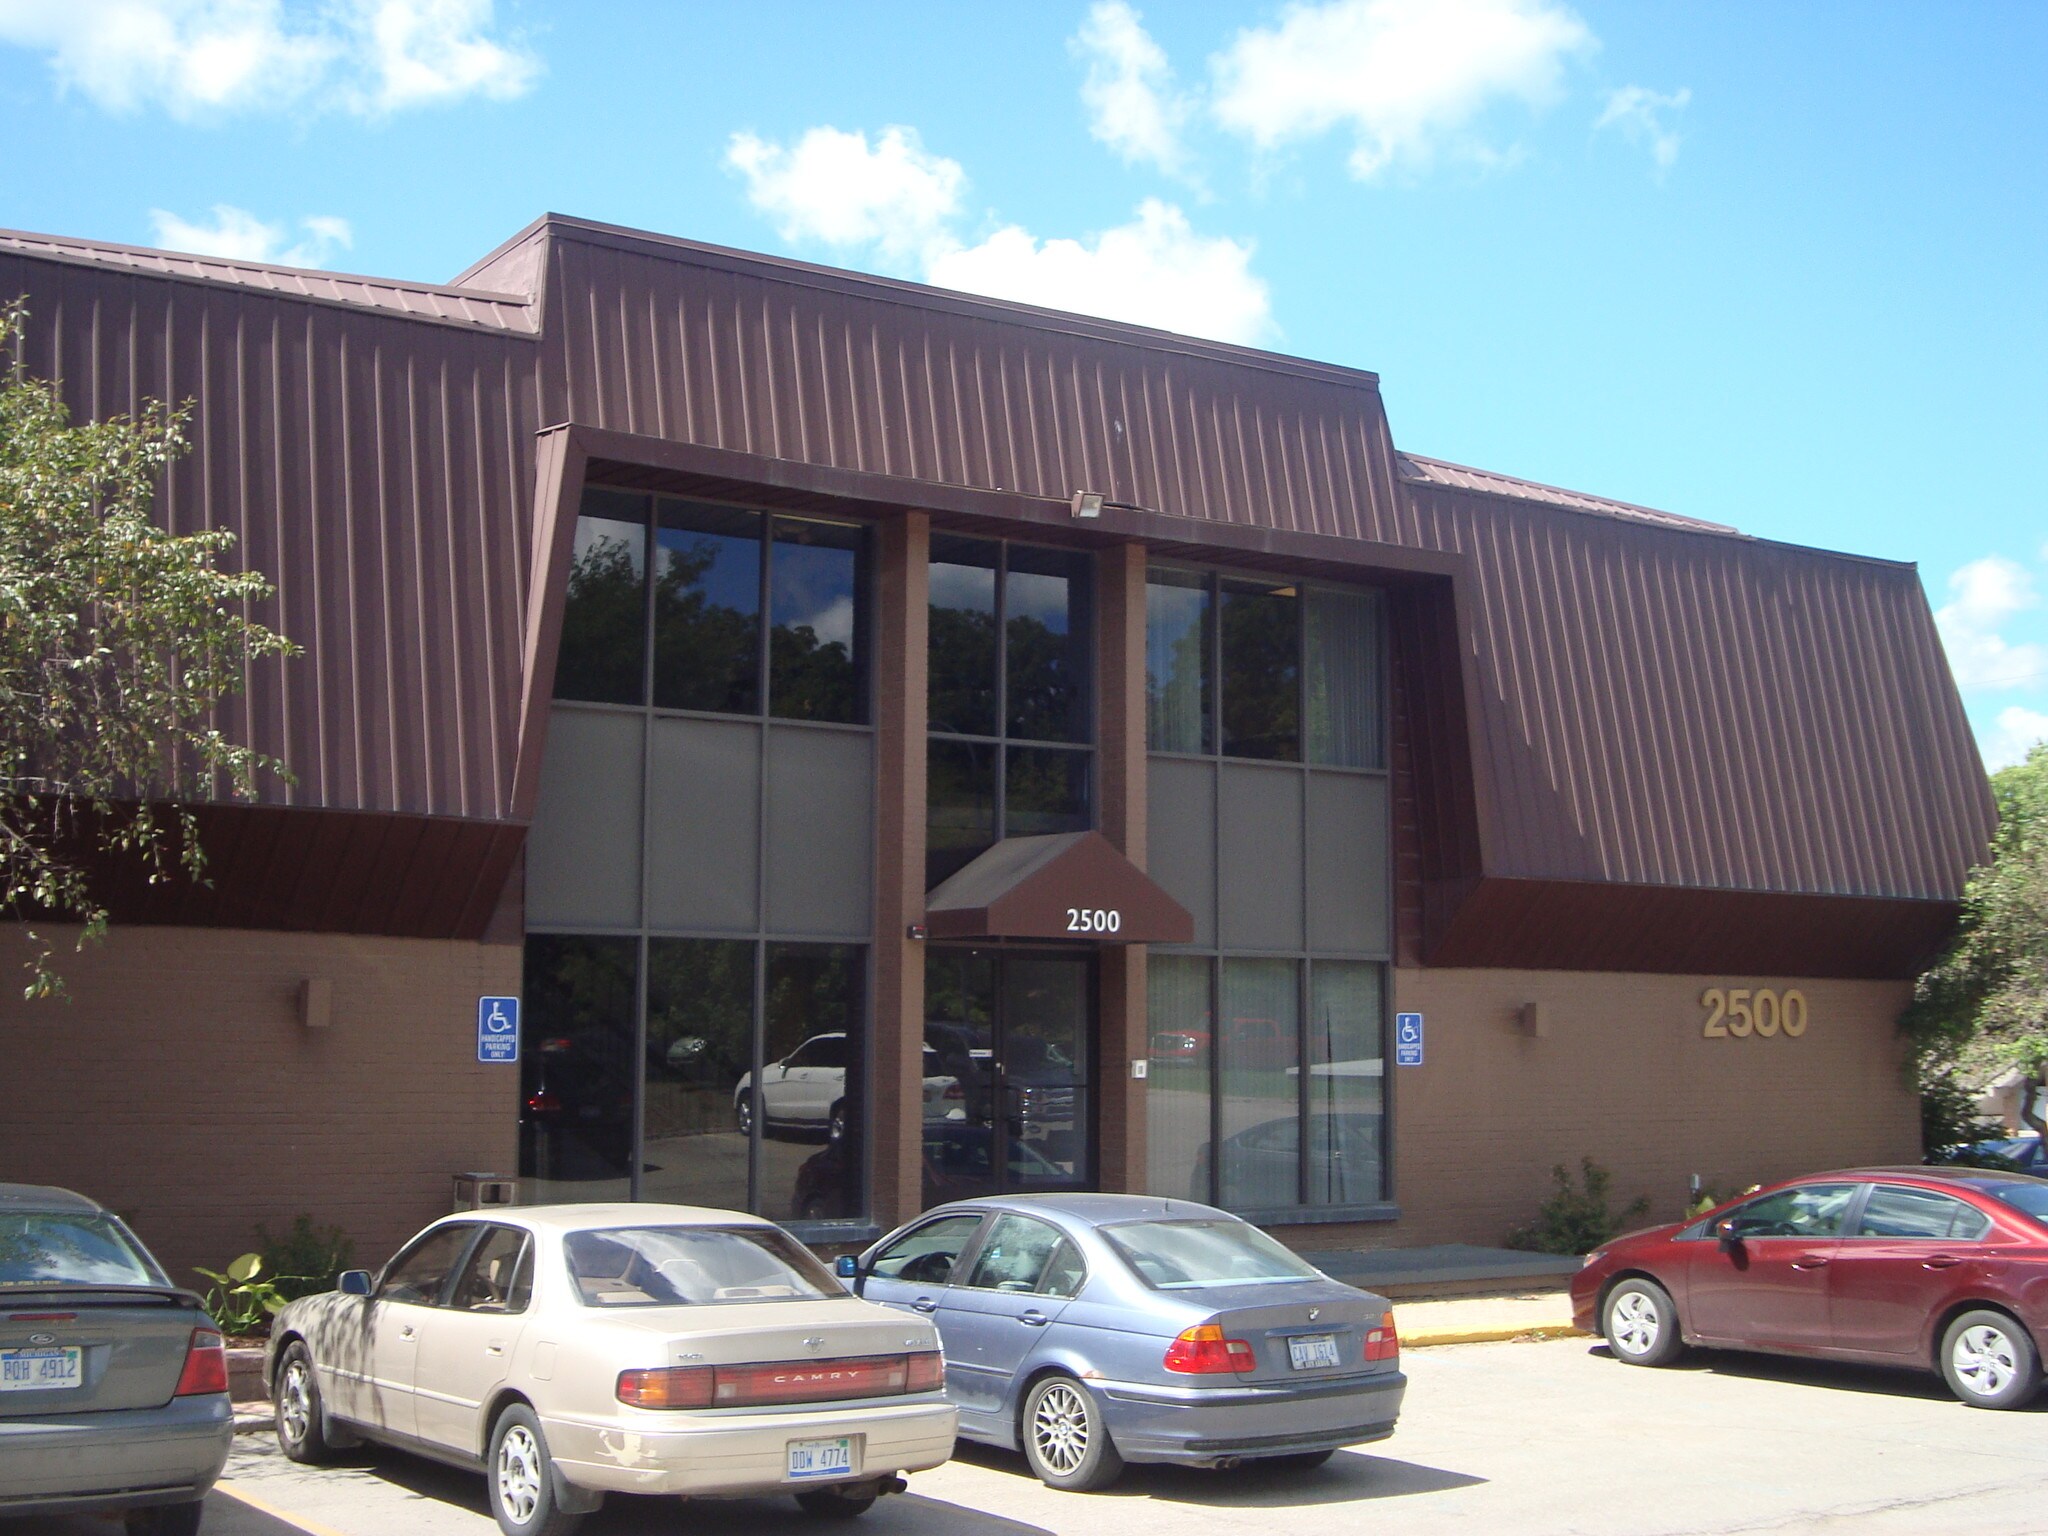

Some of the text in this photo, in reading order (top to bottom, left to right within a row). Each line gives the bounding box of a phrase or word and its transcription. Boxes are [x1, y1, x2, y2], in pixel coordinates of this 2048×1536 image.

[1066, 908, 1121, 932] 2500
[1702, 988, 1808, 1037] 2500
[485, 1043, 511, 1051] PARKING
[40, 1359, 76, 1378] 4912
[774, 1371, 859, 1383] CAMRY
[820, 1448, 848, 1467] 4774
